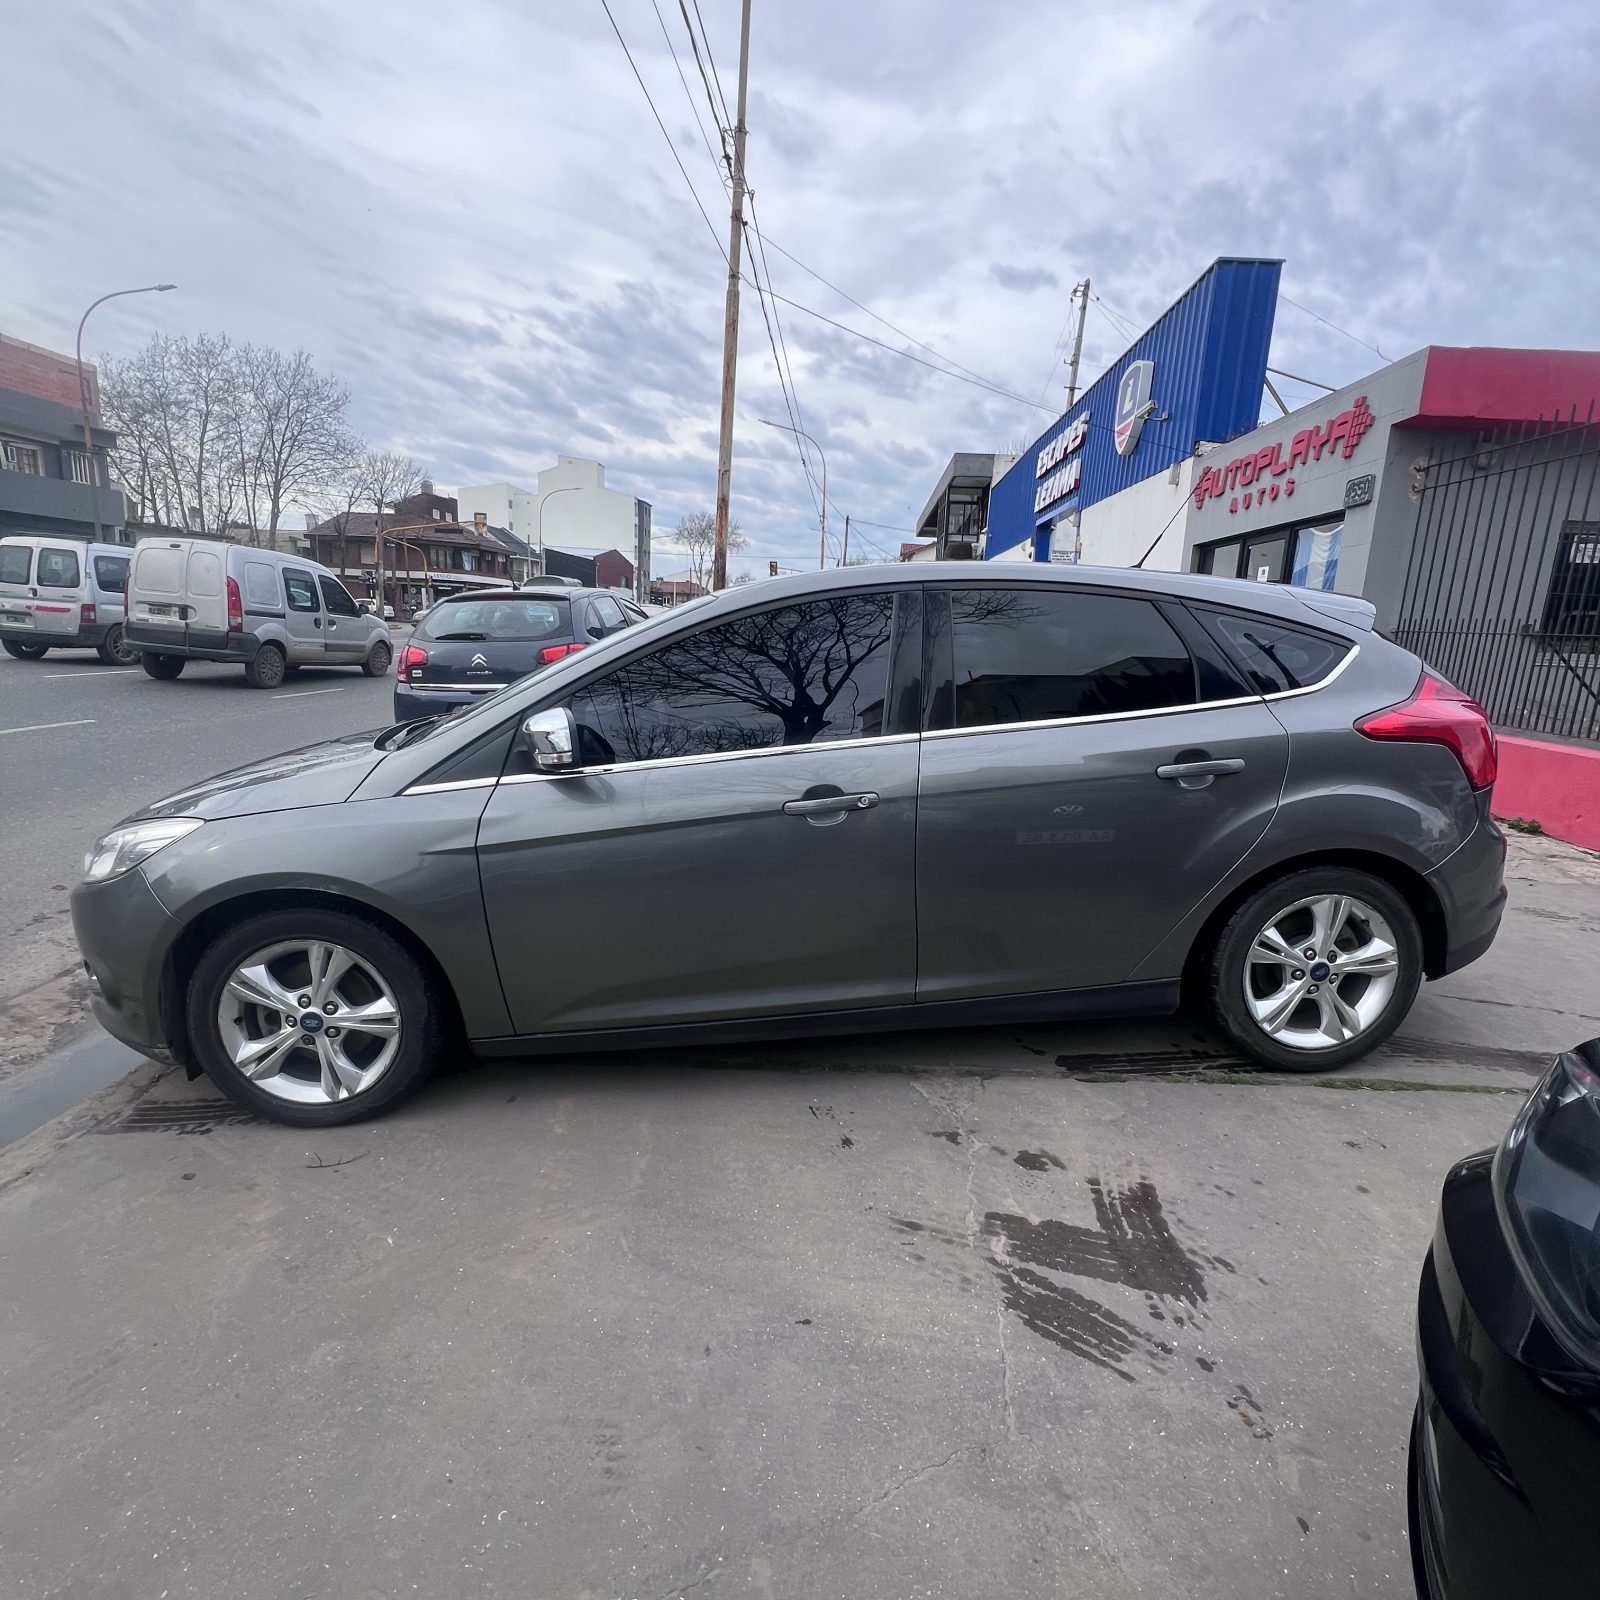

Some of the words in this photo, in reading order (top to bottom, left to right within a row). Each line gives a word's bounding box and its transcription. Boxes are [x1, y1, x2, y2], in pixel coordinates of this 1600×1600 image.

[1036, 410, 1090, 479] ESCAPES
[1199, 409, 1356, 500] AUTOPLAYA
[1034, 458, 1081, 513] LEZAMA
[1228, 477, 1297, 513] AUTOS
